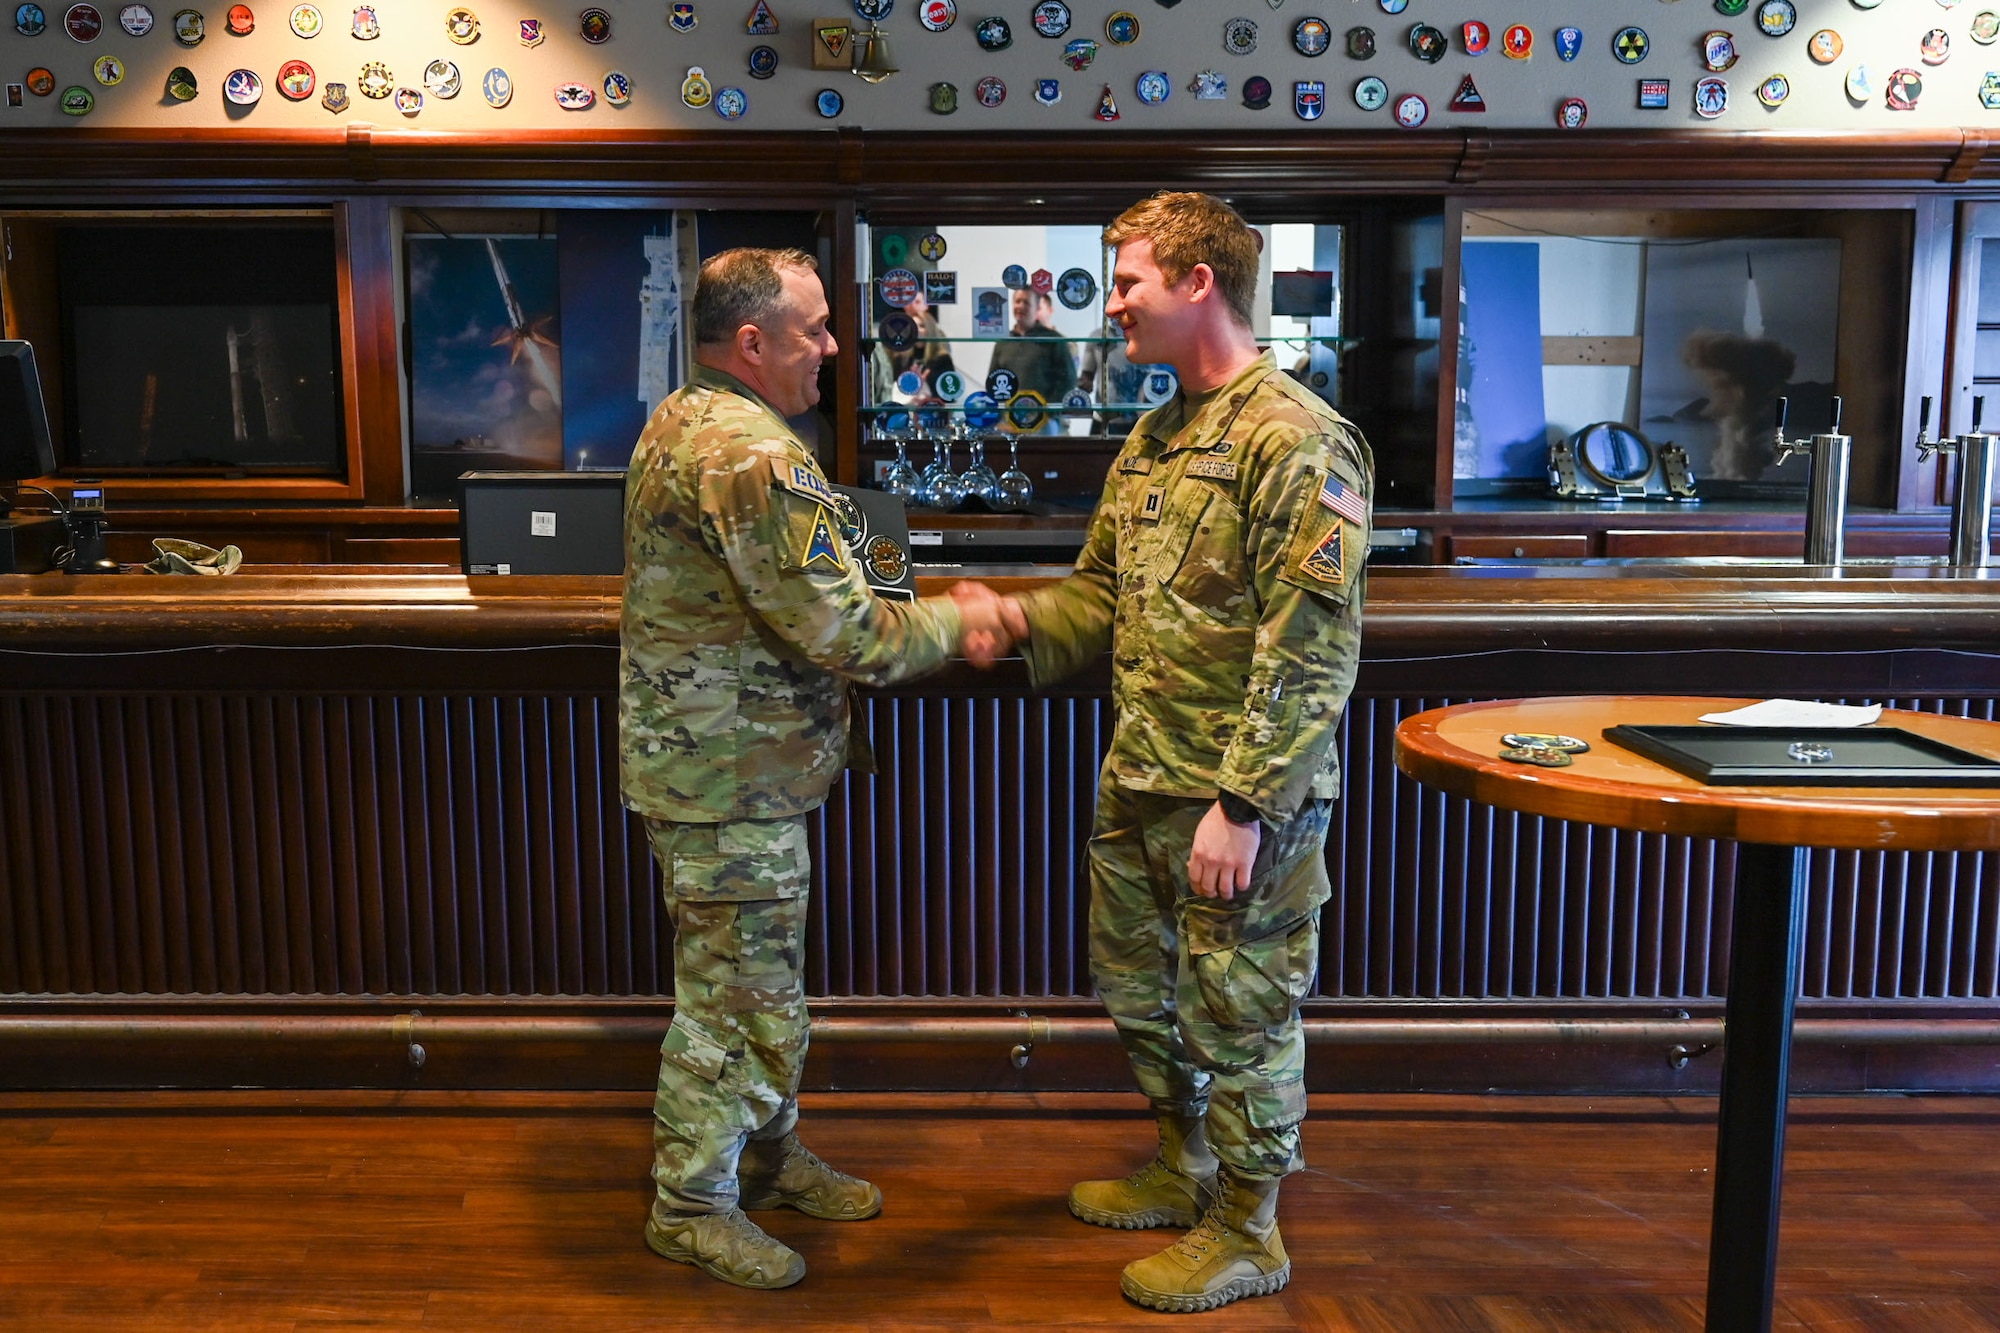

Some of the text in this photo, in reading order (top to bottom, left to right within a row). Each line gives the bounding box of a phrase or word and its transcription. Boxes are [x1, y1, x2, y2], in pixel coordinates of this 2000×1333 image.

[928, 7, 949, 19] easy
[1212, 462, 1235, 478] FORCE
[1312, 562, 1335, 575] SPACE
